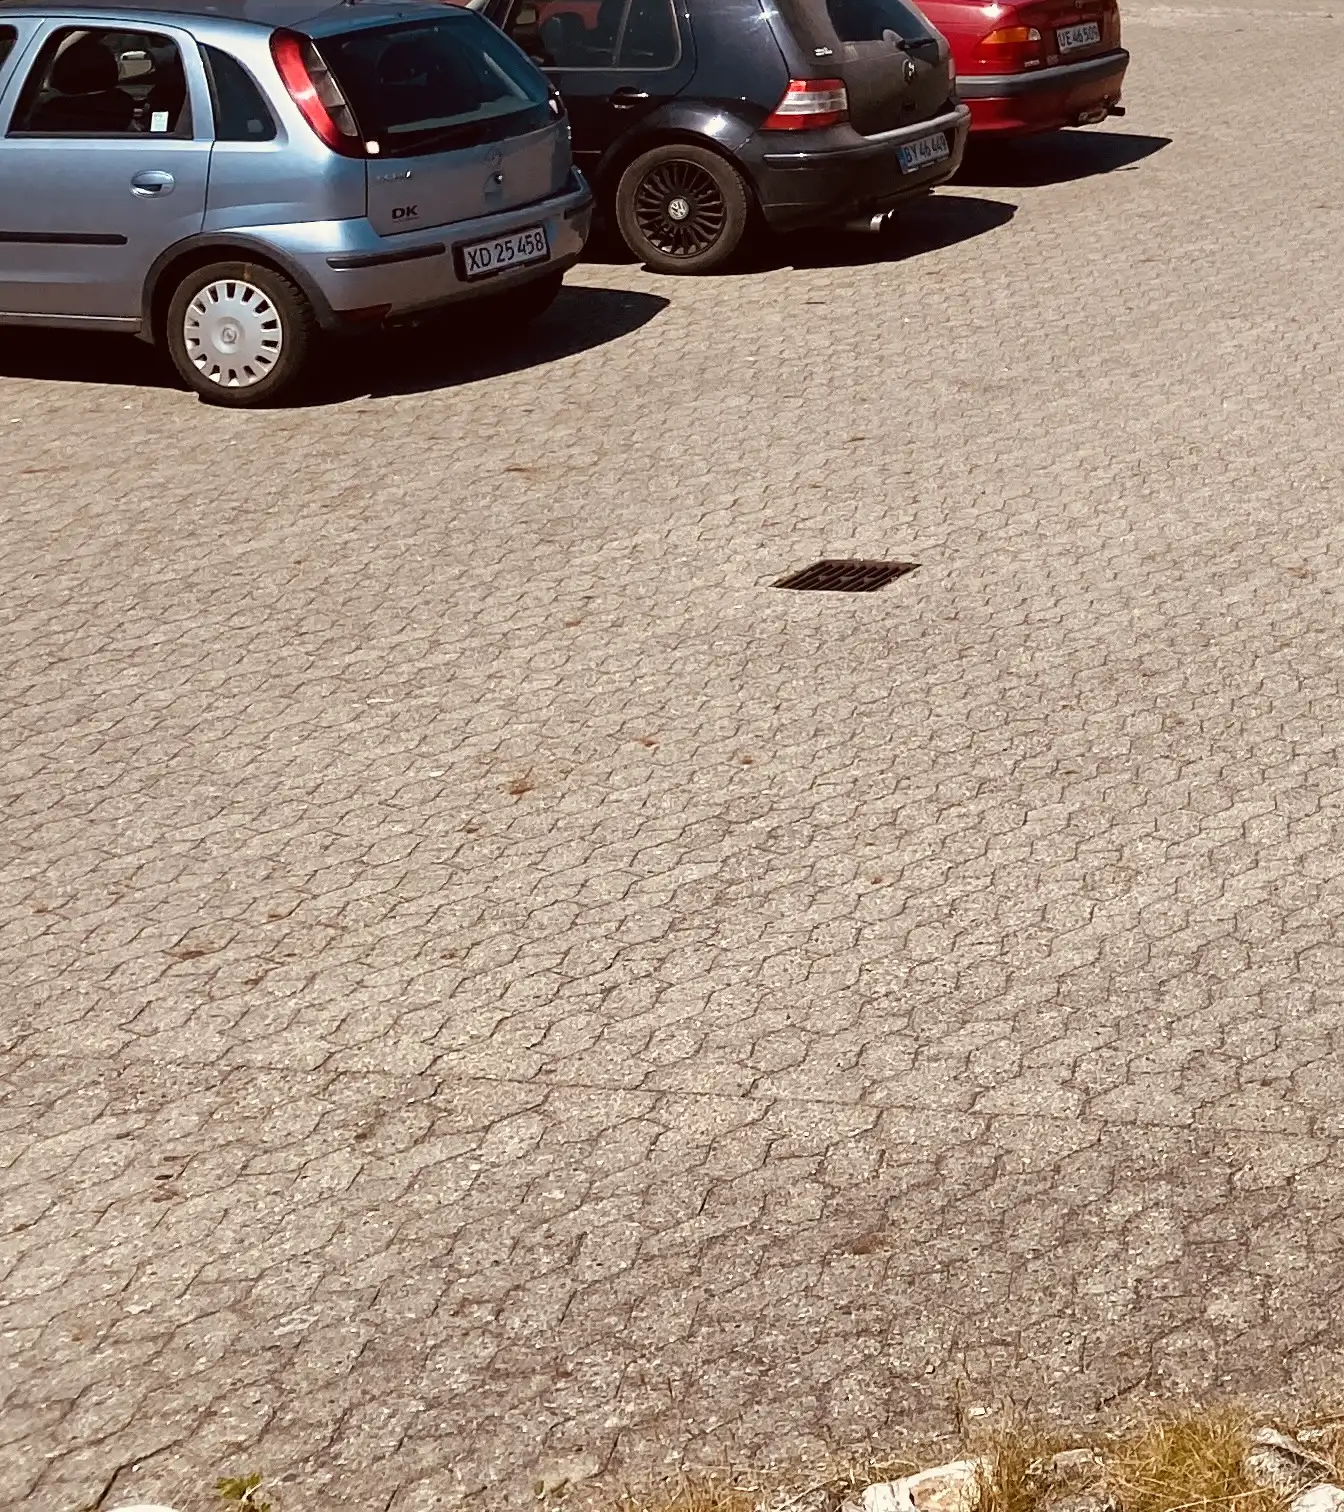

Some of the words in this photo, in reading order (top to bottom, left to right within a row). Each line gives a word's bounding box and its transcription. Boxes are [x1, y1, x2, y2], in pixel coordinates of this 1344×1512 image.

[391, 205, 418, 220] DK
[466, 247, 492, 272] XD
[494, 240, 514, 264] 25
[517, 231, 545, 255] 458
